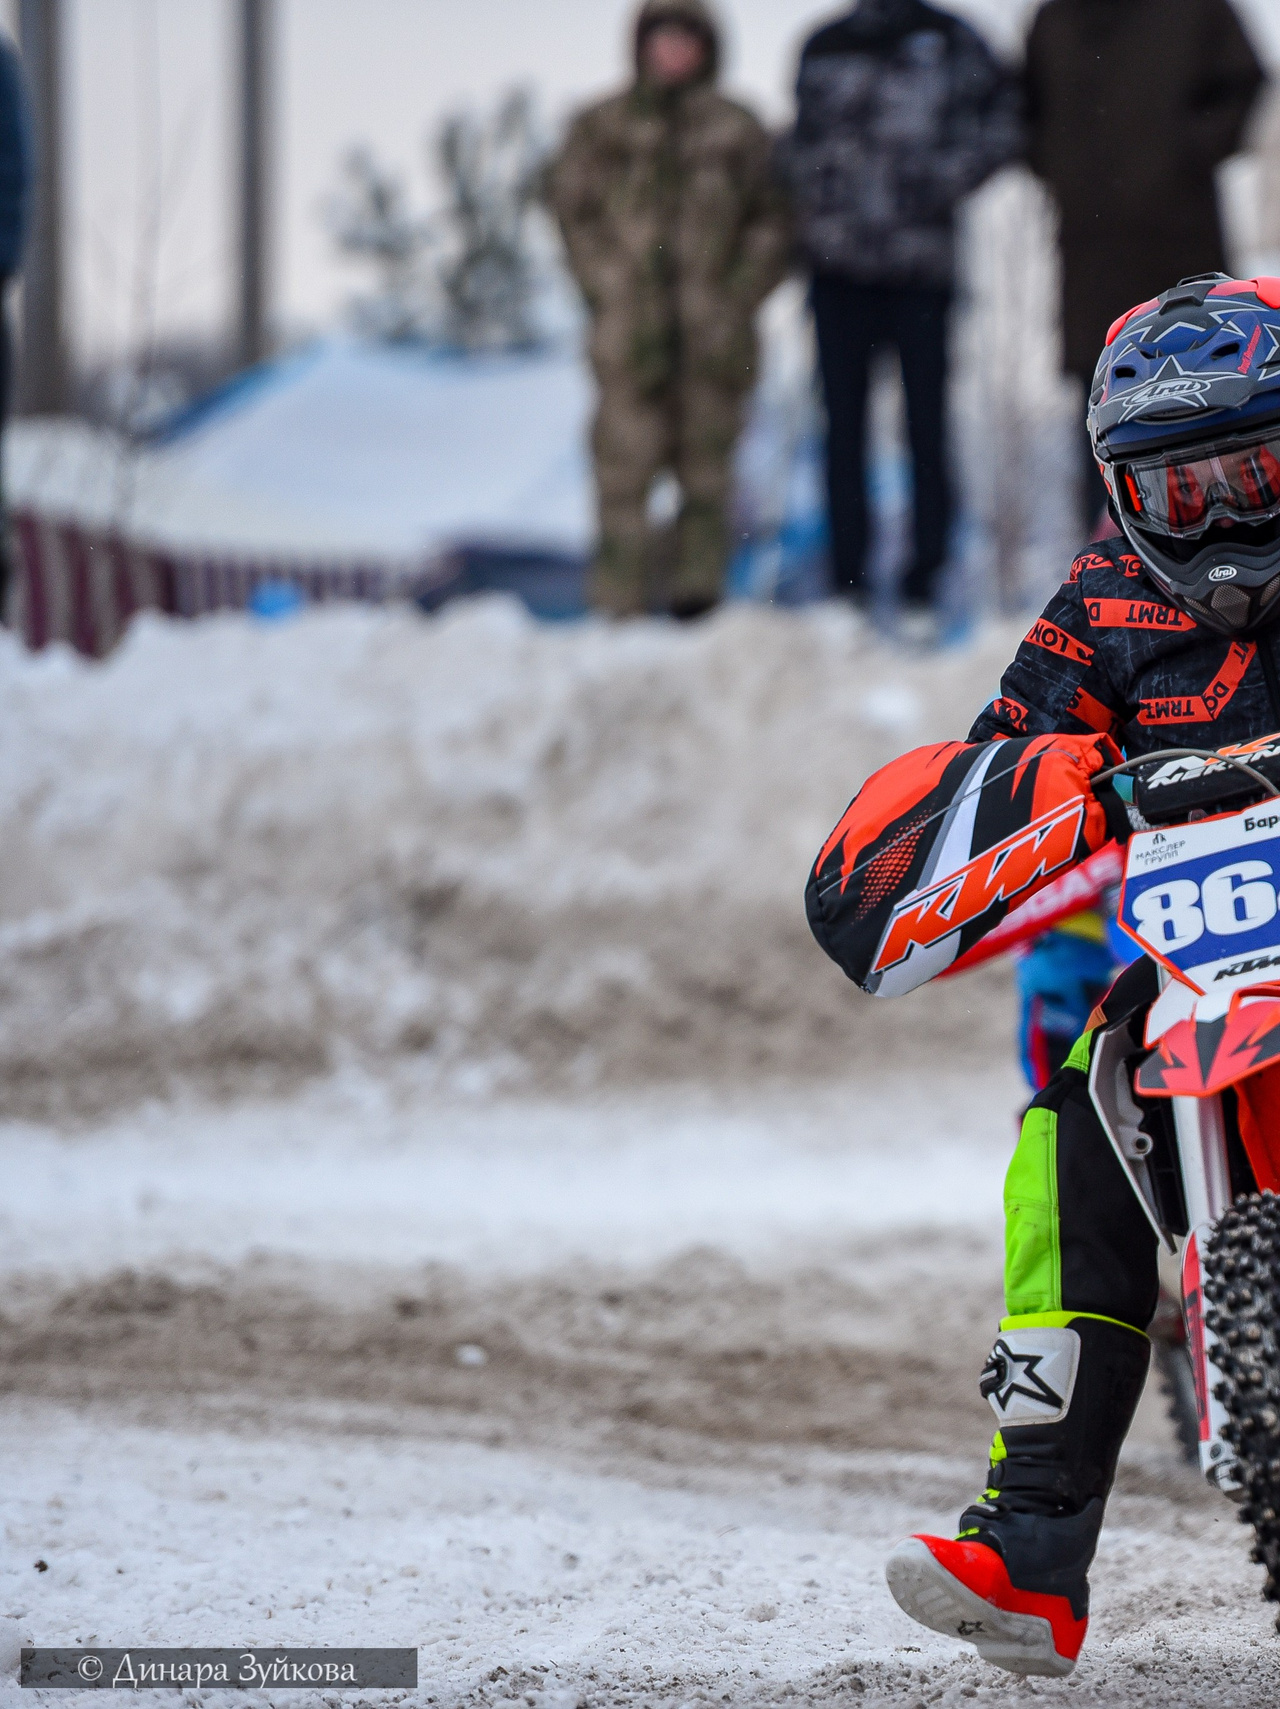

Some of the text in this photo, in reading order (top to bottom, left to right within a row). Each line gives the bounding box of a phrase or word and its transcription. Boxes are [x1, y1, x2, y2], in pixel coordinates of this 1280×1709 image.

[1211, 567, 1235, 579] Arai
[1126, 603, 1183, 626] TRMT
[1140, 702, 1196, 720] TRMT
[1135, 840, 1186, 860] МАКСЛЕР
[1144, 850, 1179, 865] ГРУПП
[871, 795, 1085, 975] KTM
